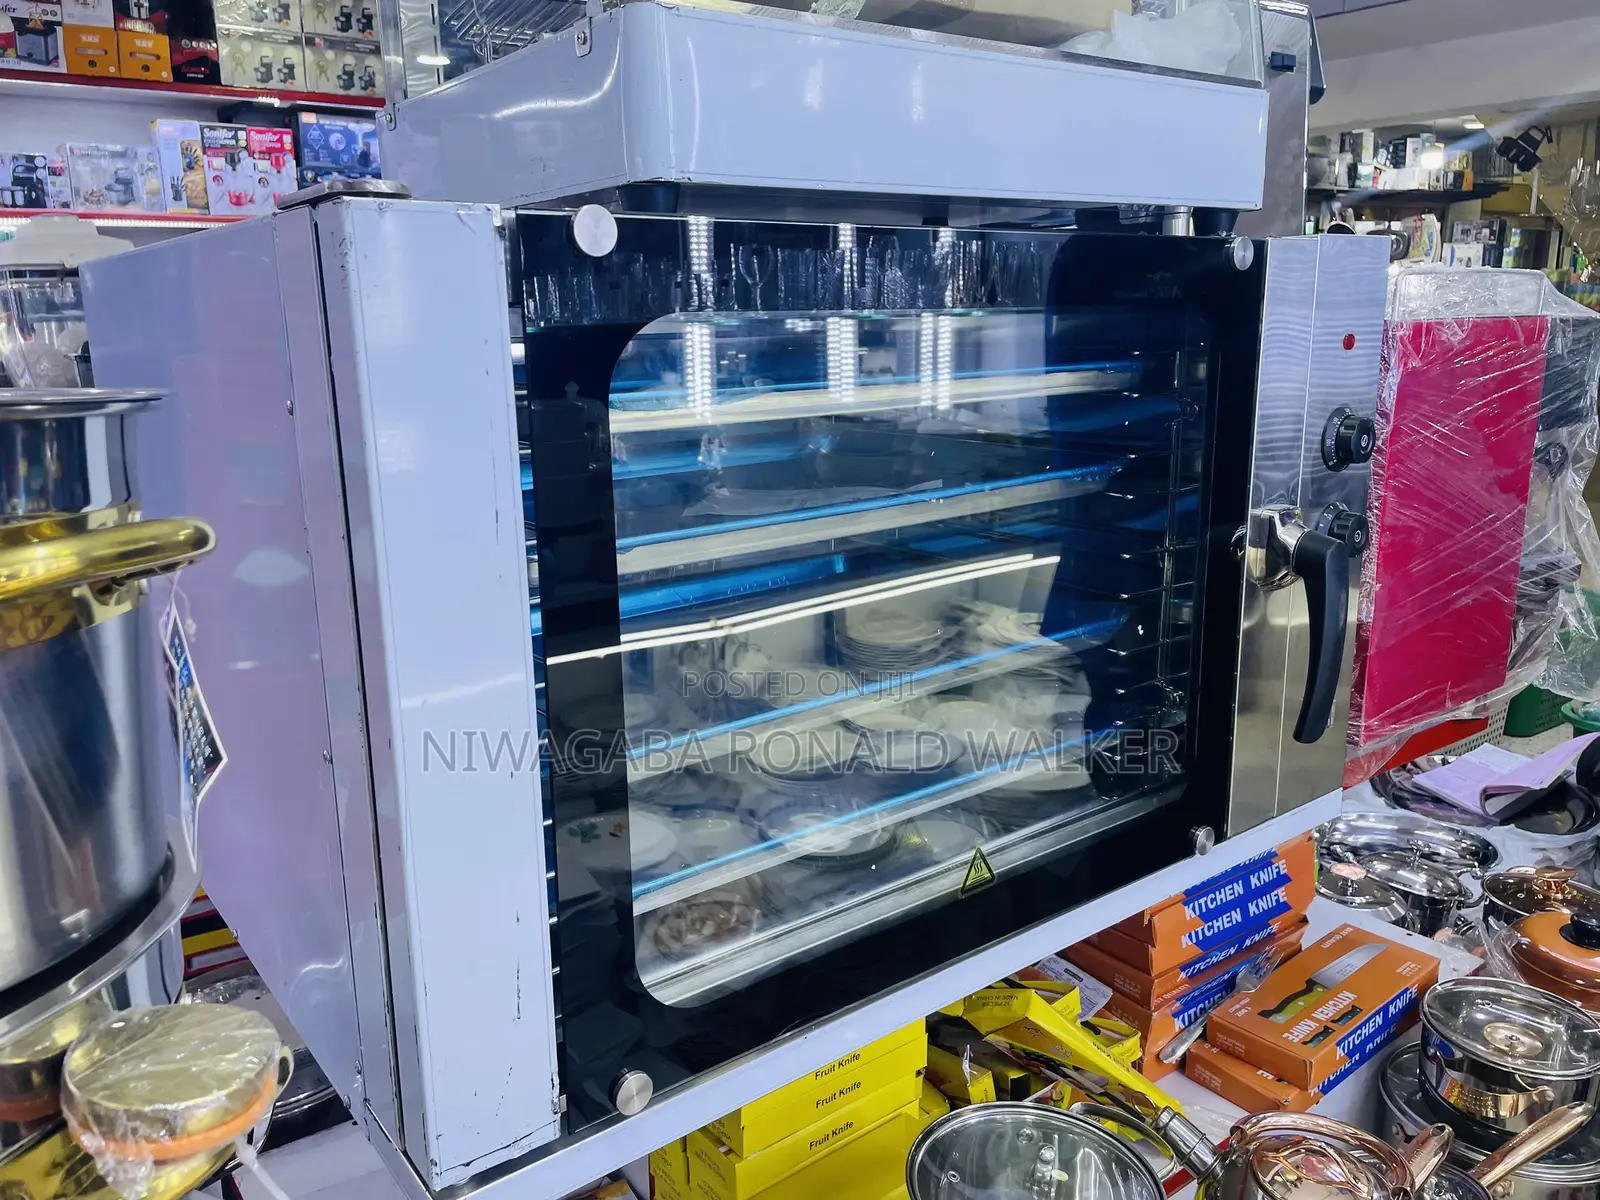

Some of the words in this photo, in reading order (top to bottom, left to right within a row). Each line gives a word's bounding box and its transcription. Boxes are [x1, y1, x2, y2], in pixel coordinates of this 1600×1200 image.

[203, 127, 235, 139] Sonifer
[250, 130, 280, 143] Sonifer
[1184, 880, 1244, 921] KITCHEN
[1249, 859, 1288, 890] KNIFE
[1181, 908, 1242, 949] KITCHEN
[1247, 886, 1288, 918] KNIFE
[1176, 944, 1239, 983] KITCHEN
[1242, 920, 1282, 949] KNIFE
[1172, 971, 1233, 1011] KITCHEN
[1311, 990, 1358, 1021] KITCHEN
[1282, 1018, 1319, 1043] KNIFE
[1336, 1011, 1384, 1060] KITCHEN
[1388, 984, 1418, 1018] KNIFE
[815, 1065, 836, 1081] Fruit
[837, 1053, 861, 1070] Knife
[815, 1093, 837, 1109] Fruit
[838, 1081, 862, 1098] Knife
[809, 1134, 830, 1151] Fruit
[831, 1121, 854, 1138] Knife
